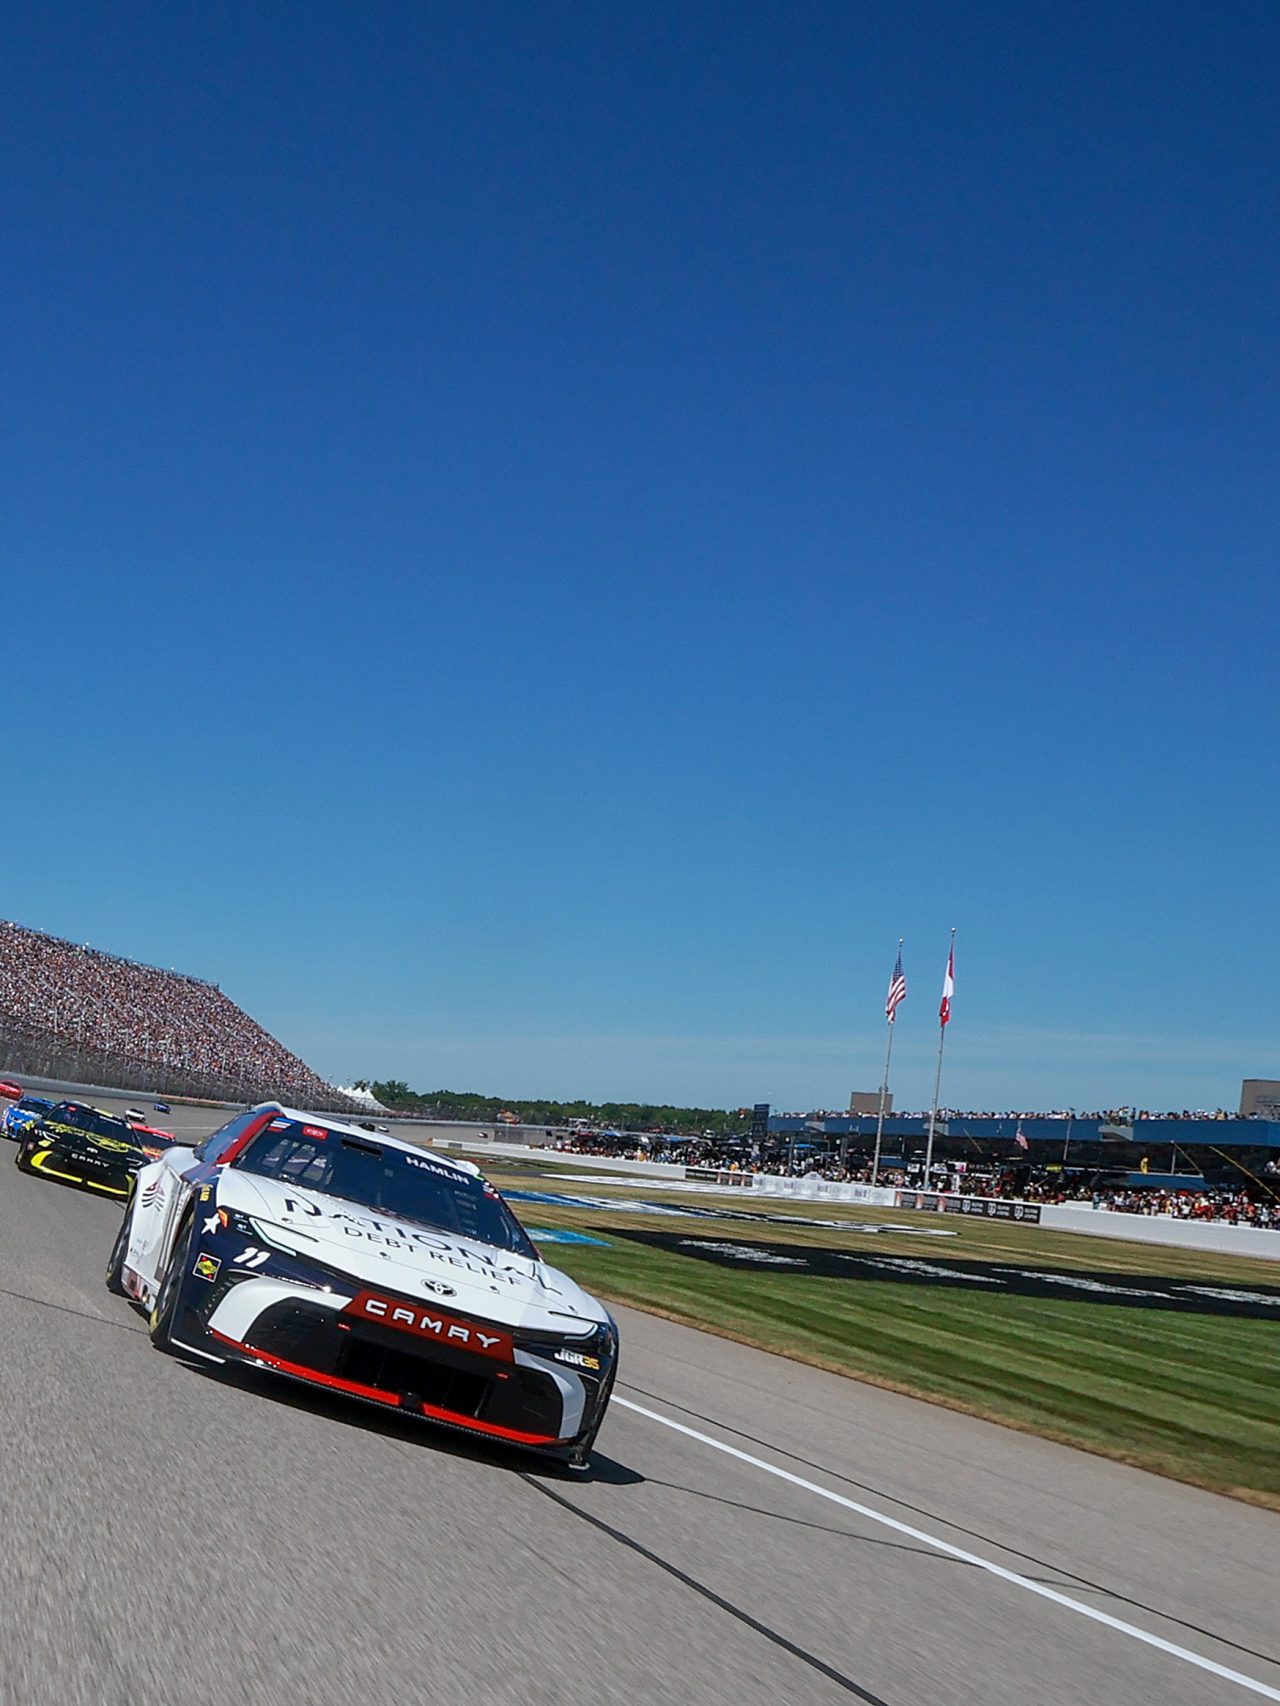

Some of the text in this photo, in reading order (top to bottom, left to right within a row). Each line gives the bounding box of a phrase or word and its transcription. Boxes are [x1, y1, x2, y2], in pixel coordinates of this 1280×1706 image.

[405, 1156, 470, 1185] HAMLIN
[232, 1246, 271, 1269] 11
[284, 1198, 563, 1296] NATIONAL
[344, 1226, 522, 1286] DEBT RELIEF
[365, 1299, 501, 1348] CAMRY
